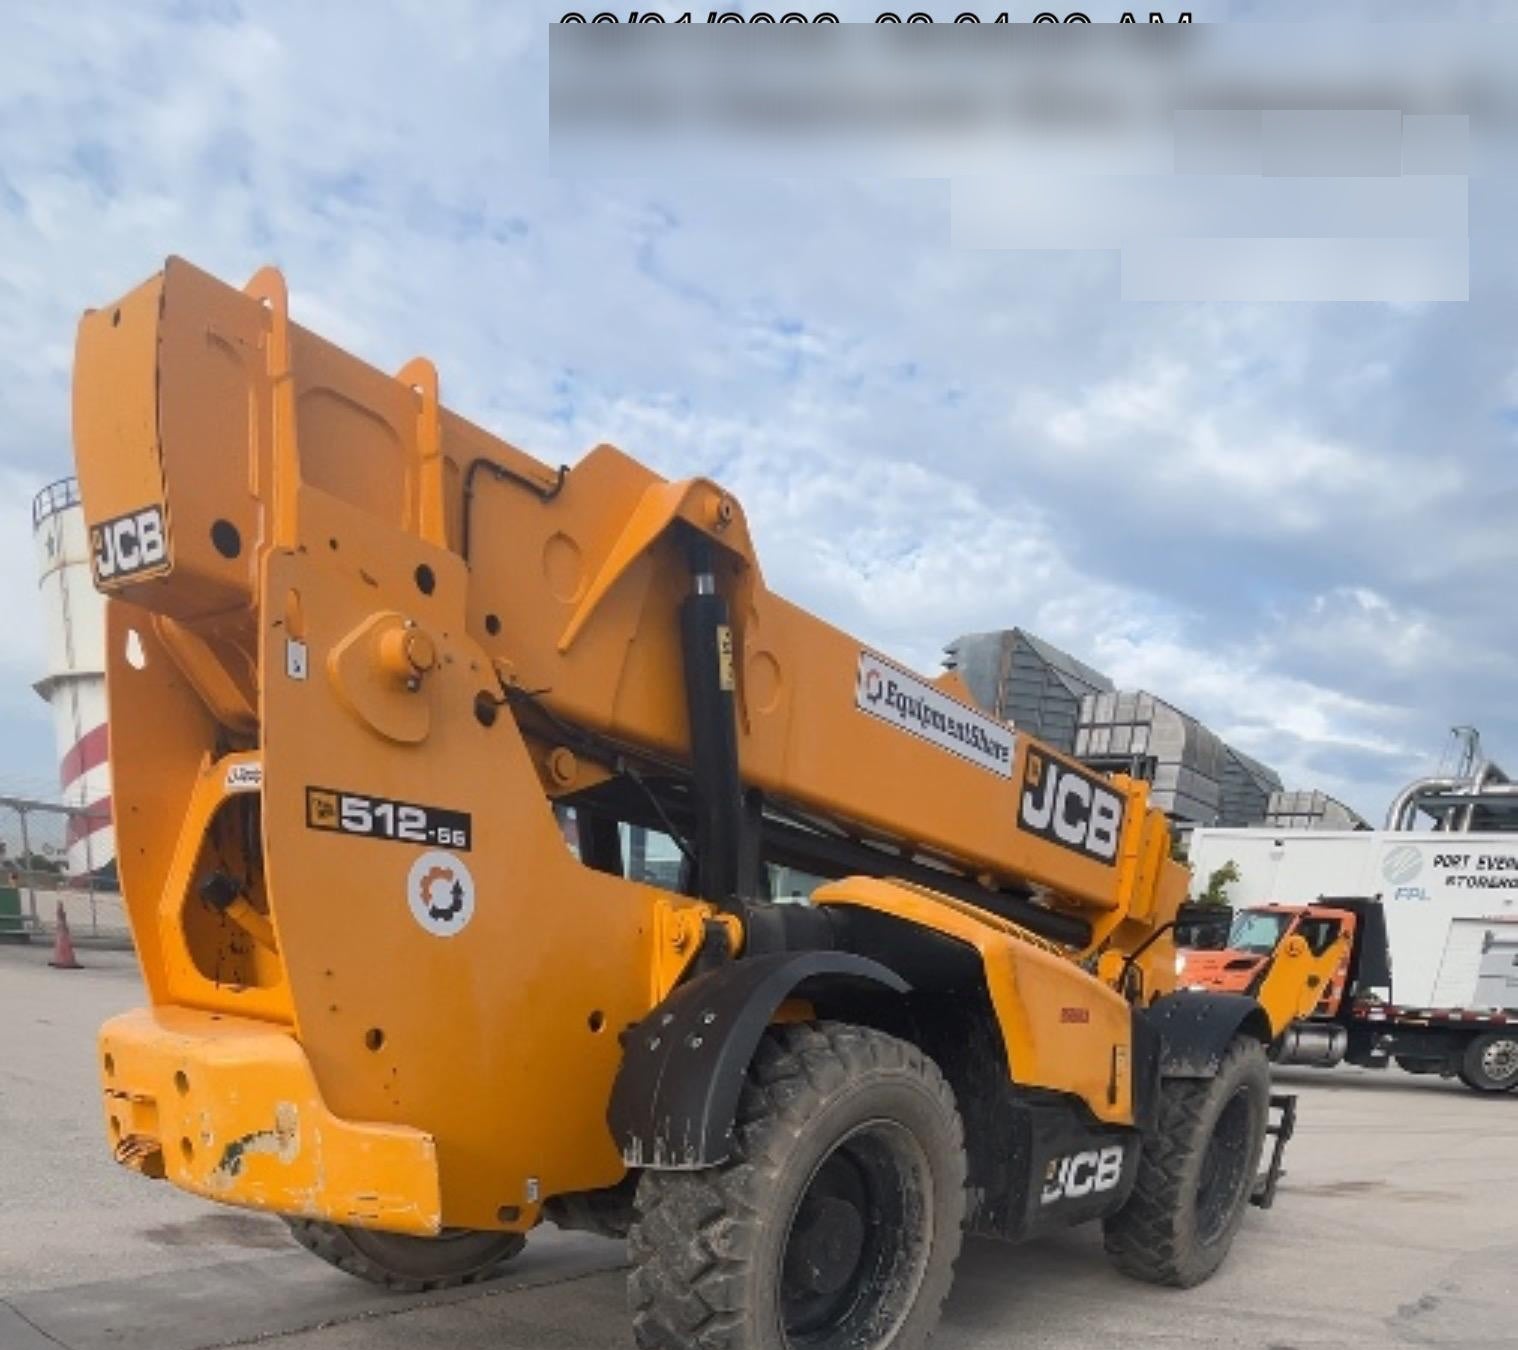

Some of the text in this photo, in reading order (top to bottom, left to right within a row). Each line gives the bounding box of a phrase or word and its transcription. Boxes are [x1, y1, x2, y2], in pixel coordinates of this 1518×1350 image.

[96, 510, 163, 576] JCB
[884, 679, 1009, 763] EquipmentShare
[1022, 762, 1122, 859] JCB
[1433, 854, 1471, 869] PORT
[1041, 1145, 1123, 1204] JCB
